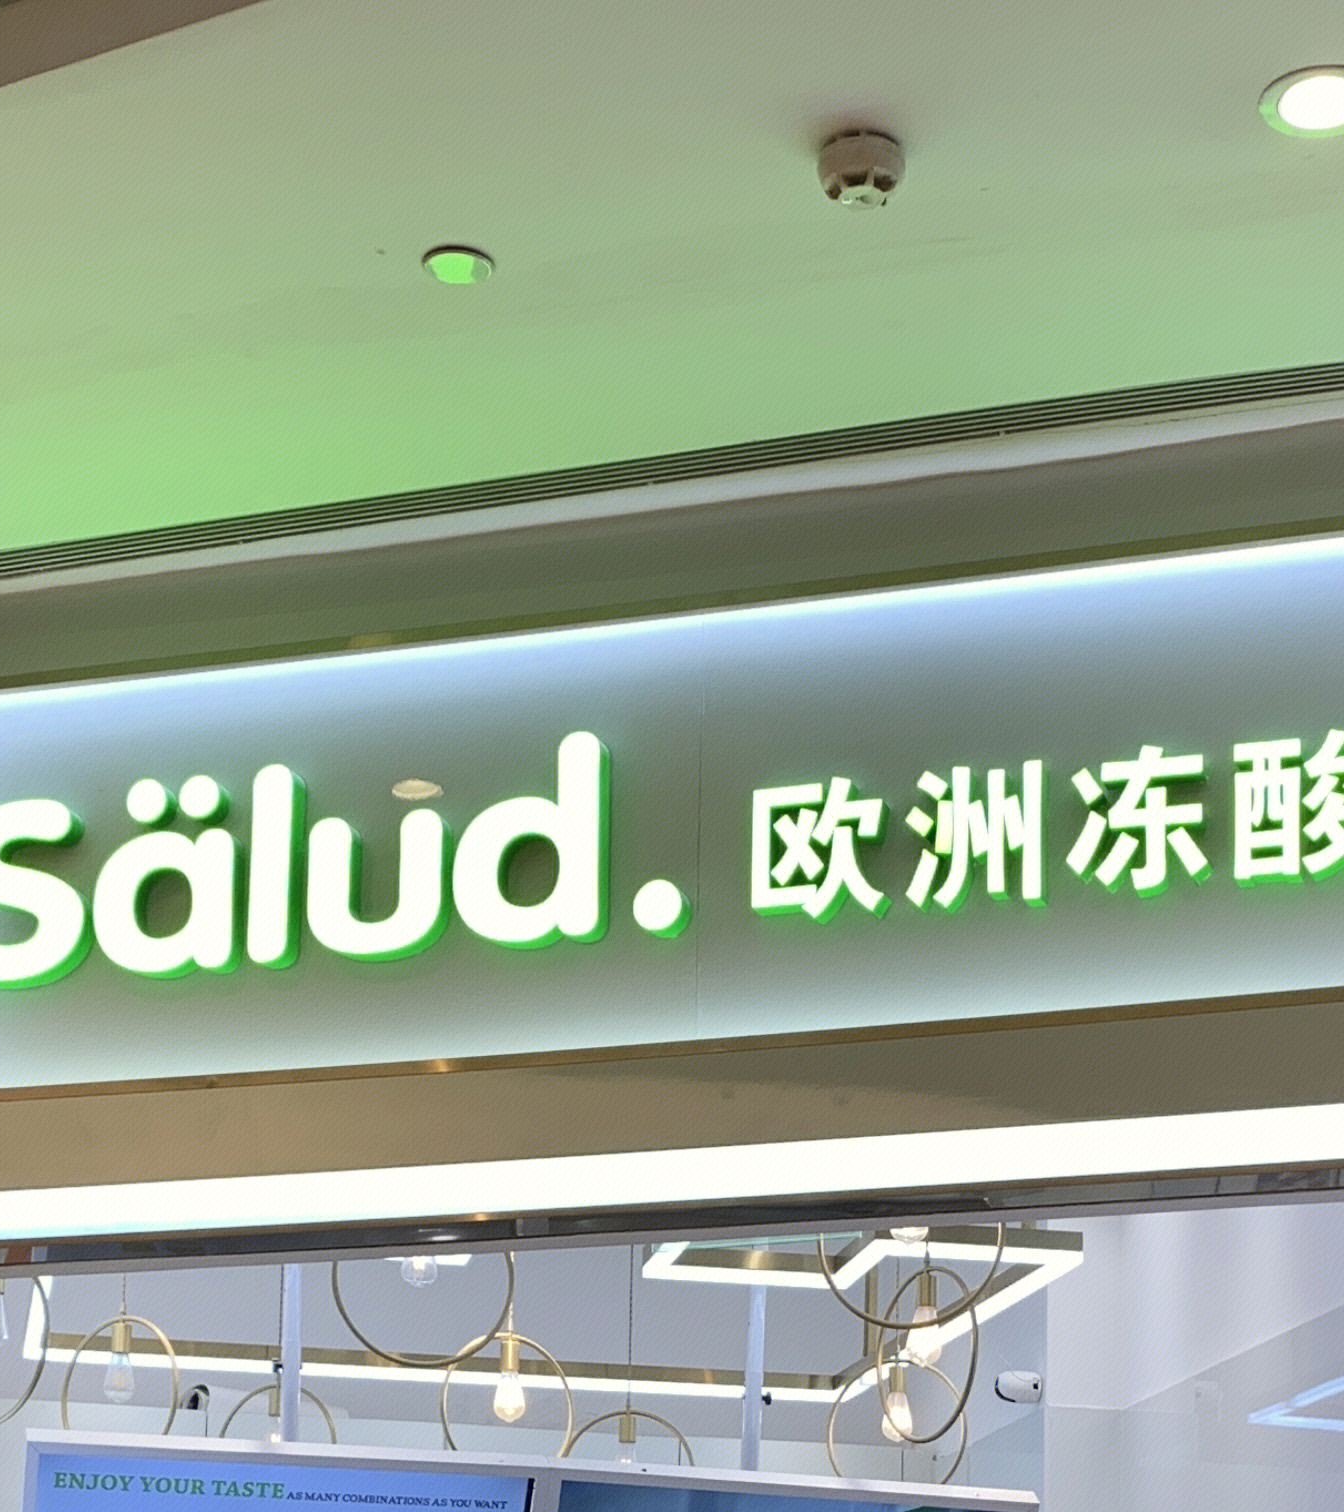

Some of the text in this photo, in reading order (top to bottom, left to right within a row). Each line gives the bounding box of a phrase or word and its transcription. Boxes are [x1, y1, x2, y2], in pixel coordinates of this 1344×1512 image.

[53, 1472, 508, 1510] ENJOY YOUR TASTE AS MANY COMBINATIONS AS YOU WANT
